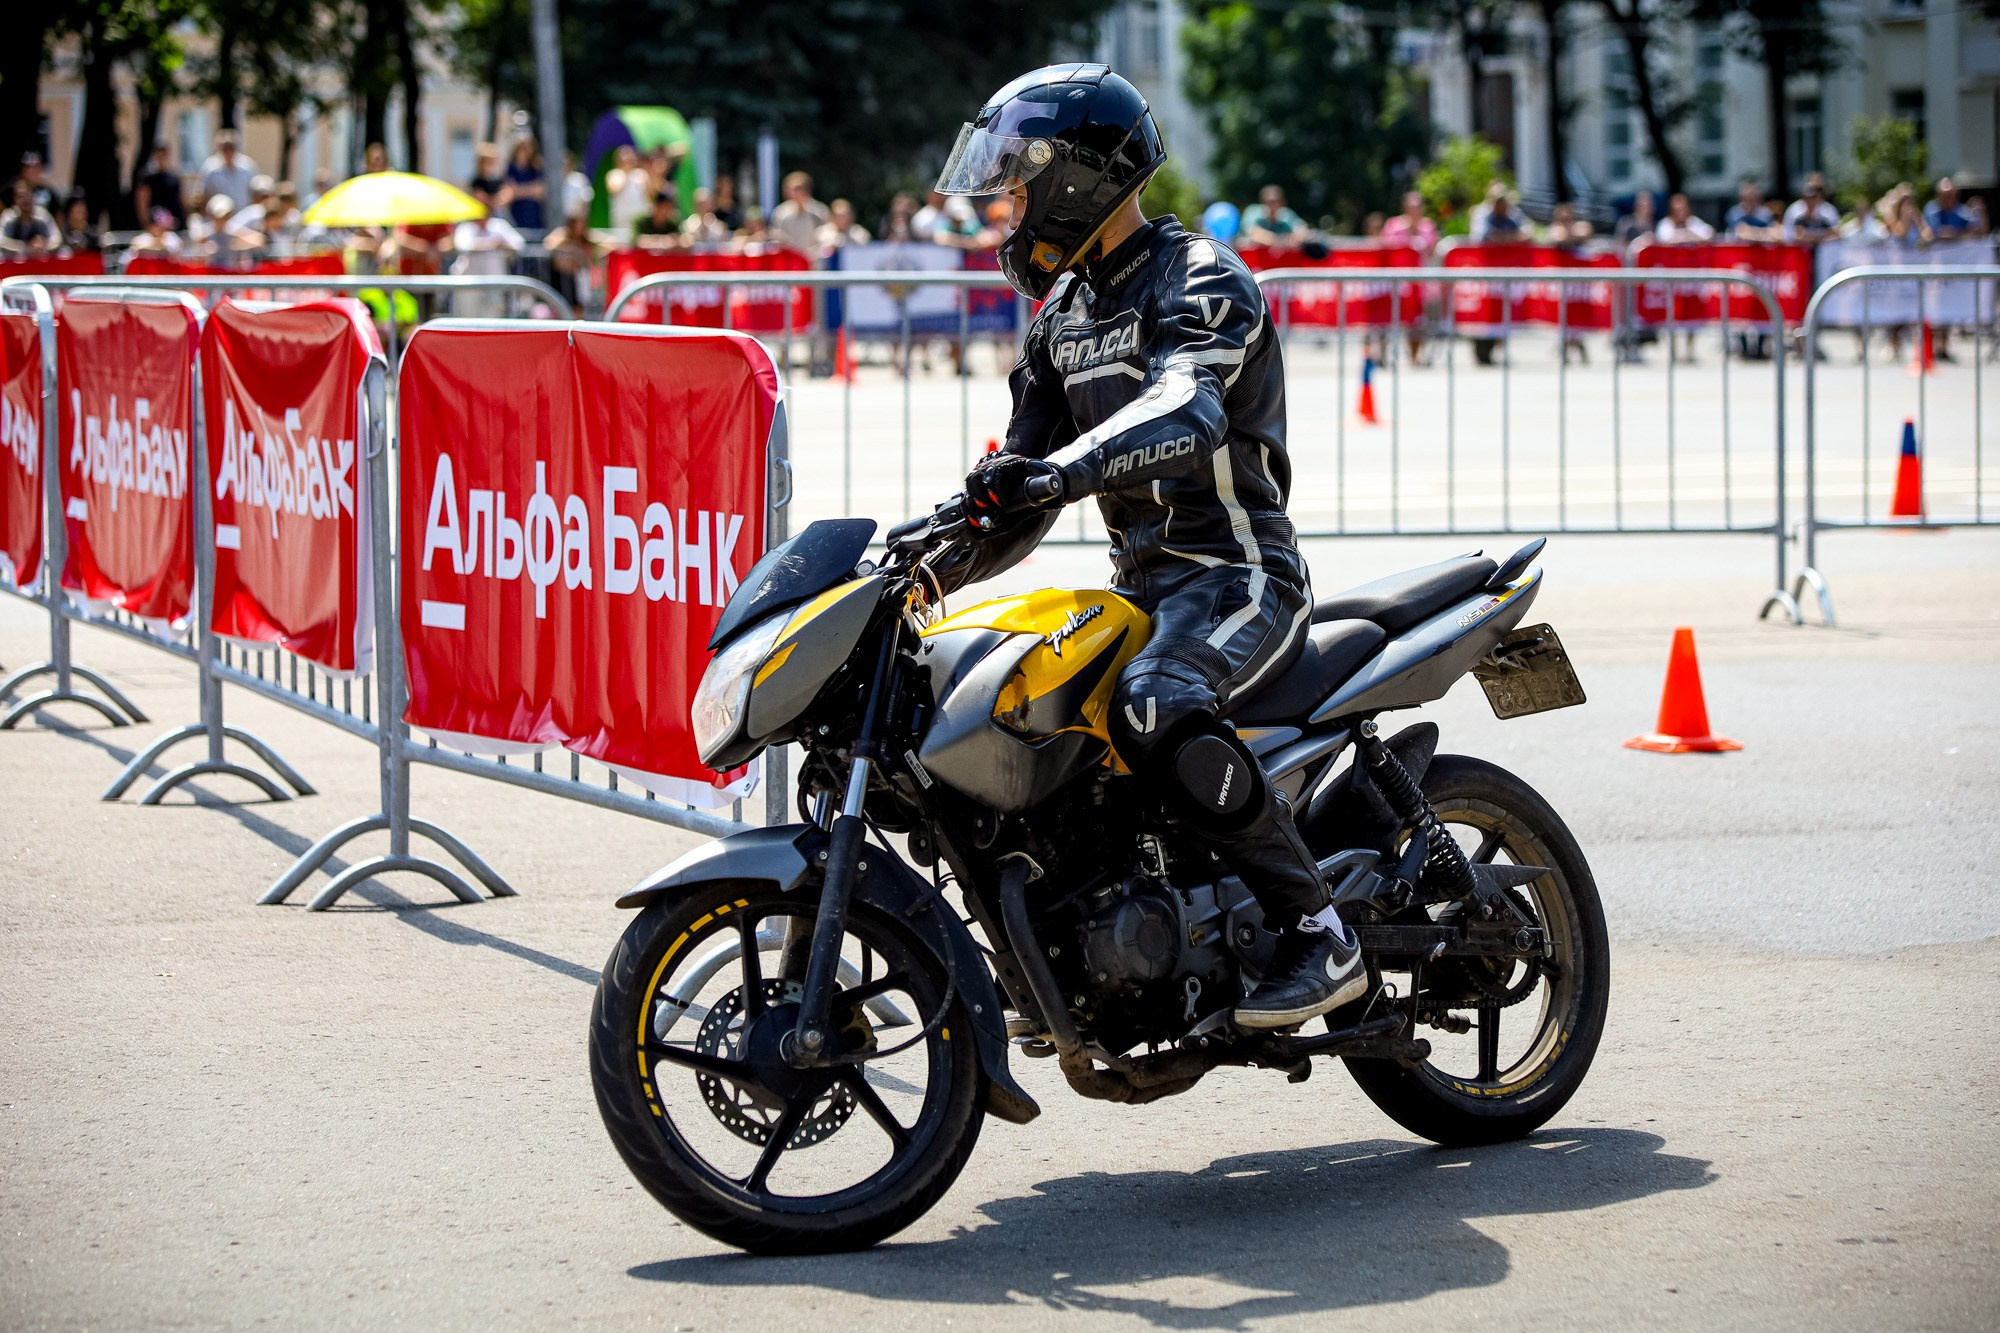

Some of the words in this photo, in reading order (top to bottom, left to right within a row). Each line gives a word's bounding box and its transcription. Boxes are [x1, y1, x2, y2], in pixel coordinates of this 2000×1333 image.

[1110, 249, 1150, 286] VANUCCI
[1049, 320, 1140, 371] VANUCCI
[1102, 433, 1197, 480] VANUCCI
[422, 452, 593, 619] Альфа
[603, 465, 745, 608] Банк
[1217, 763, 1234, 806] VANUCCI
